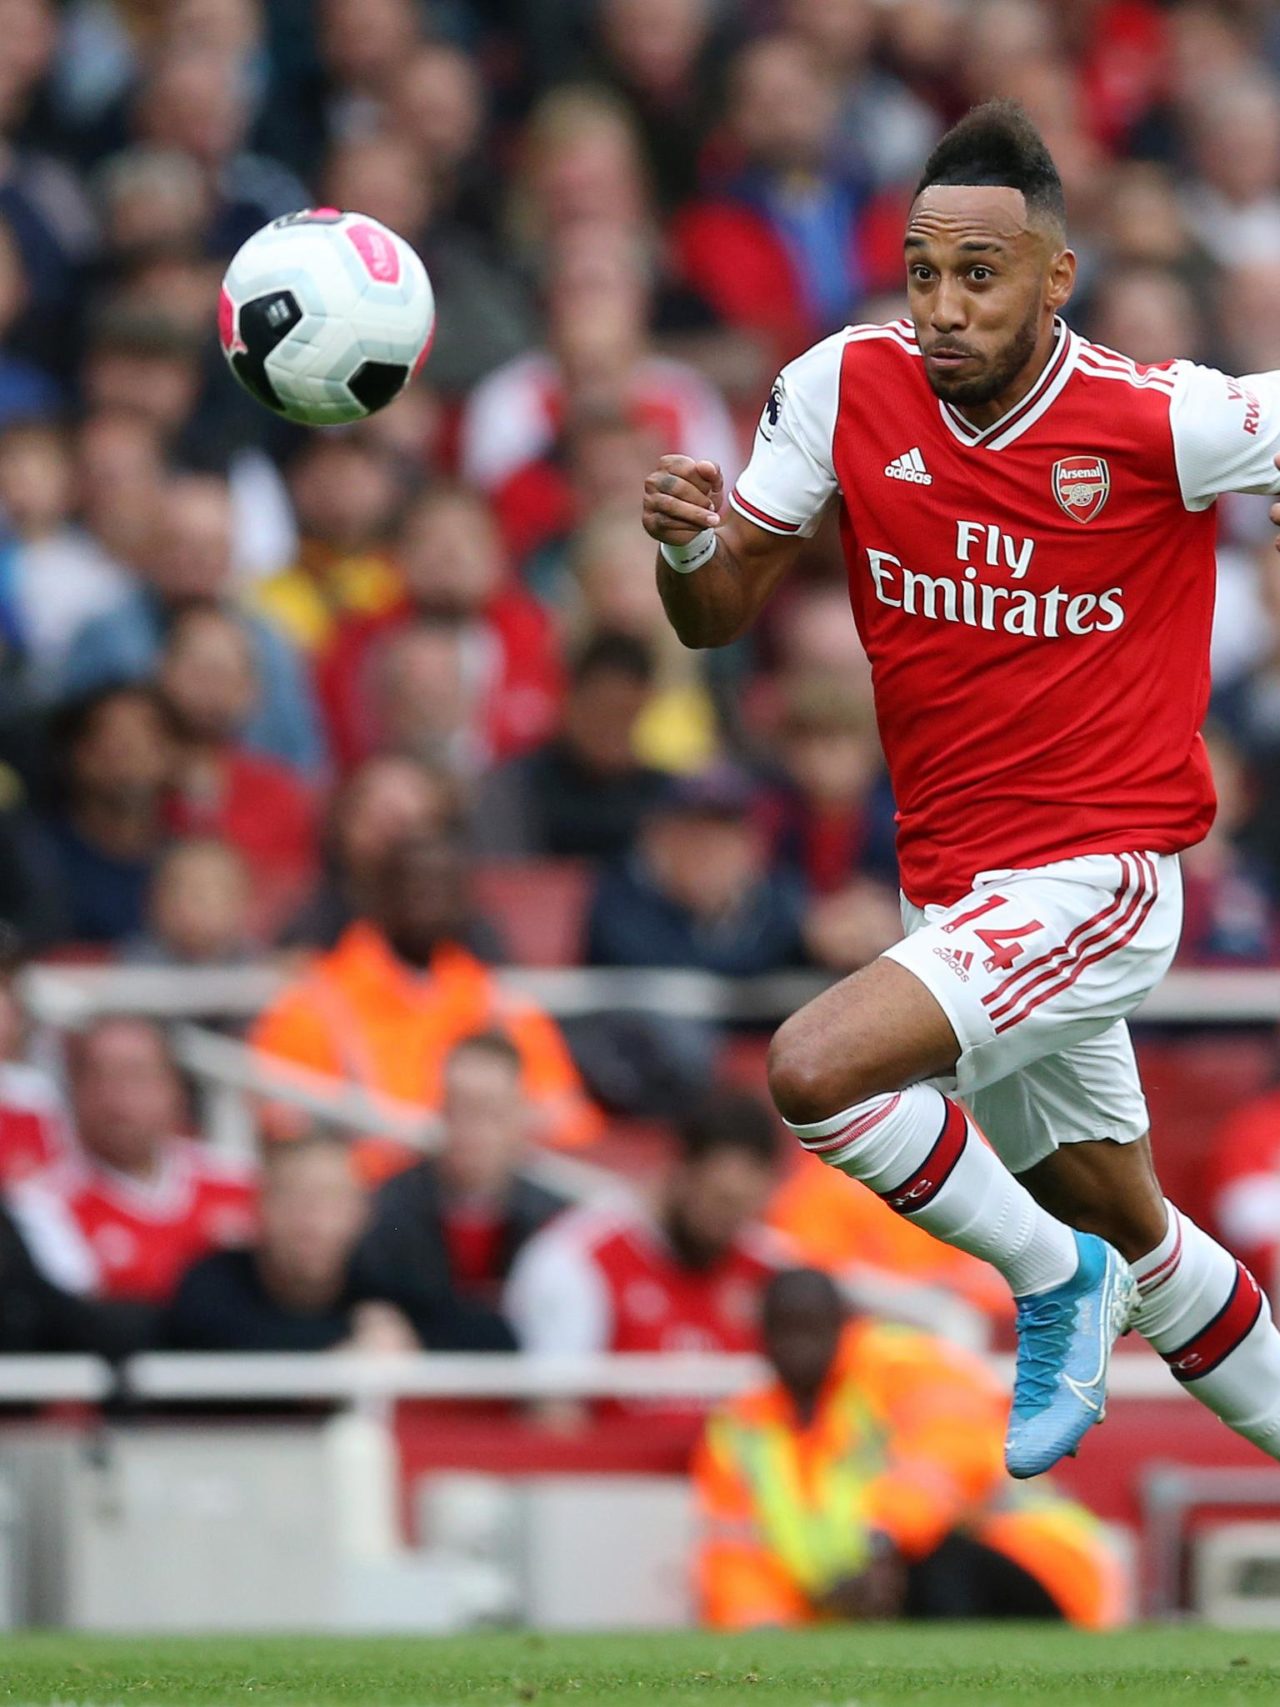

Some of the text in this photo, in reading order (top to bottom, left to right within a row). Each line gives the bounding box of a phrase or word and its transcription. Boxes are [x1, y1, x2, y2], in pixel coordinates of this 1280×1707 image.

[1243, 391, 1261, 436] RW
[884, 465, 933, 486] adidas
[1060, 465, 1101, 479] Arsenal
[956, 520, 1034, 579] Fly
[866, 547, 1124, 638] Emirates
[941, 894, 1045, 974] 14
[932, 946, 970, 983] adidas
